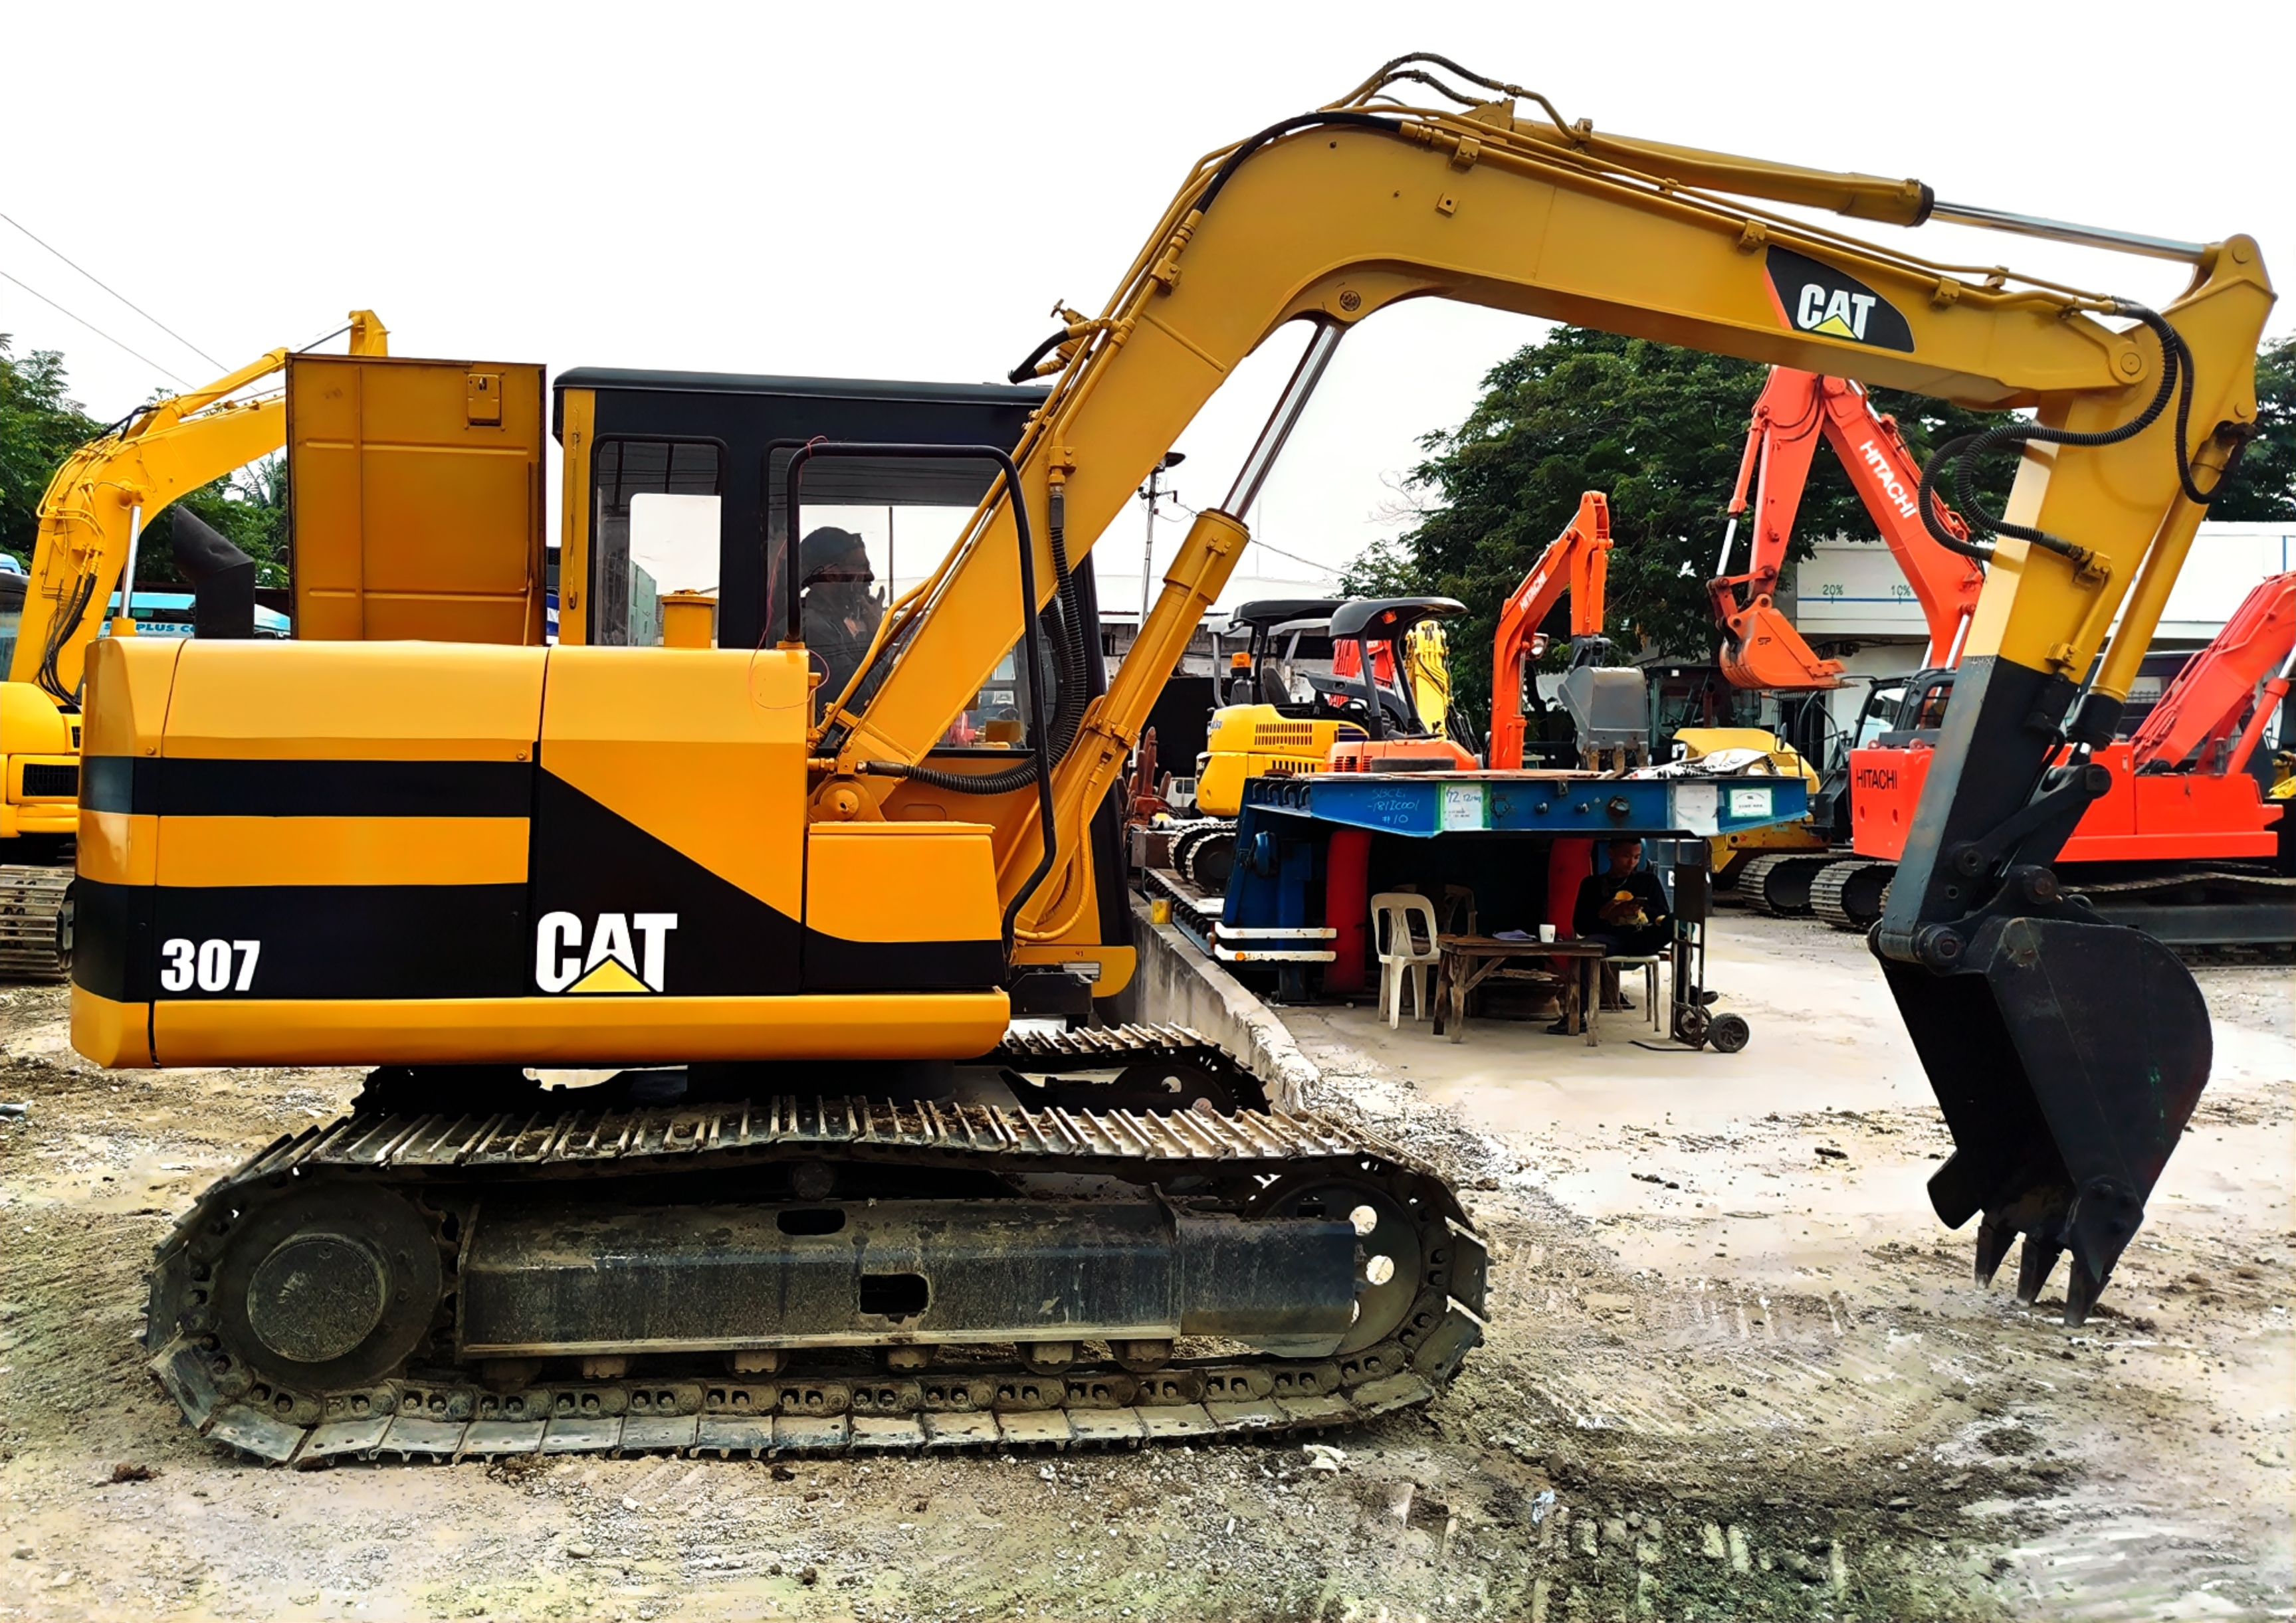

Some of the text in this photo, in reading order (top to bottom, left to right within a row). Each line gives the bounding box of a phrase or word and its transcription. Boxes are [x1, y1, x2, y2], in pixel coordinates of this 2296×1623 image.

[1797, 284, 1876, 340] CAT
[1859, 440, 1917, 518] HITACHI
[1519, 569, 1547, 613] HITACHI
[1822, 584, 1911, 596] 20% 10%
[1856, 769, 1898, 790] HITACHI
[161, 938, 261, 992] 307
[536, 911, 678, 993] CAT
